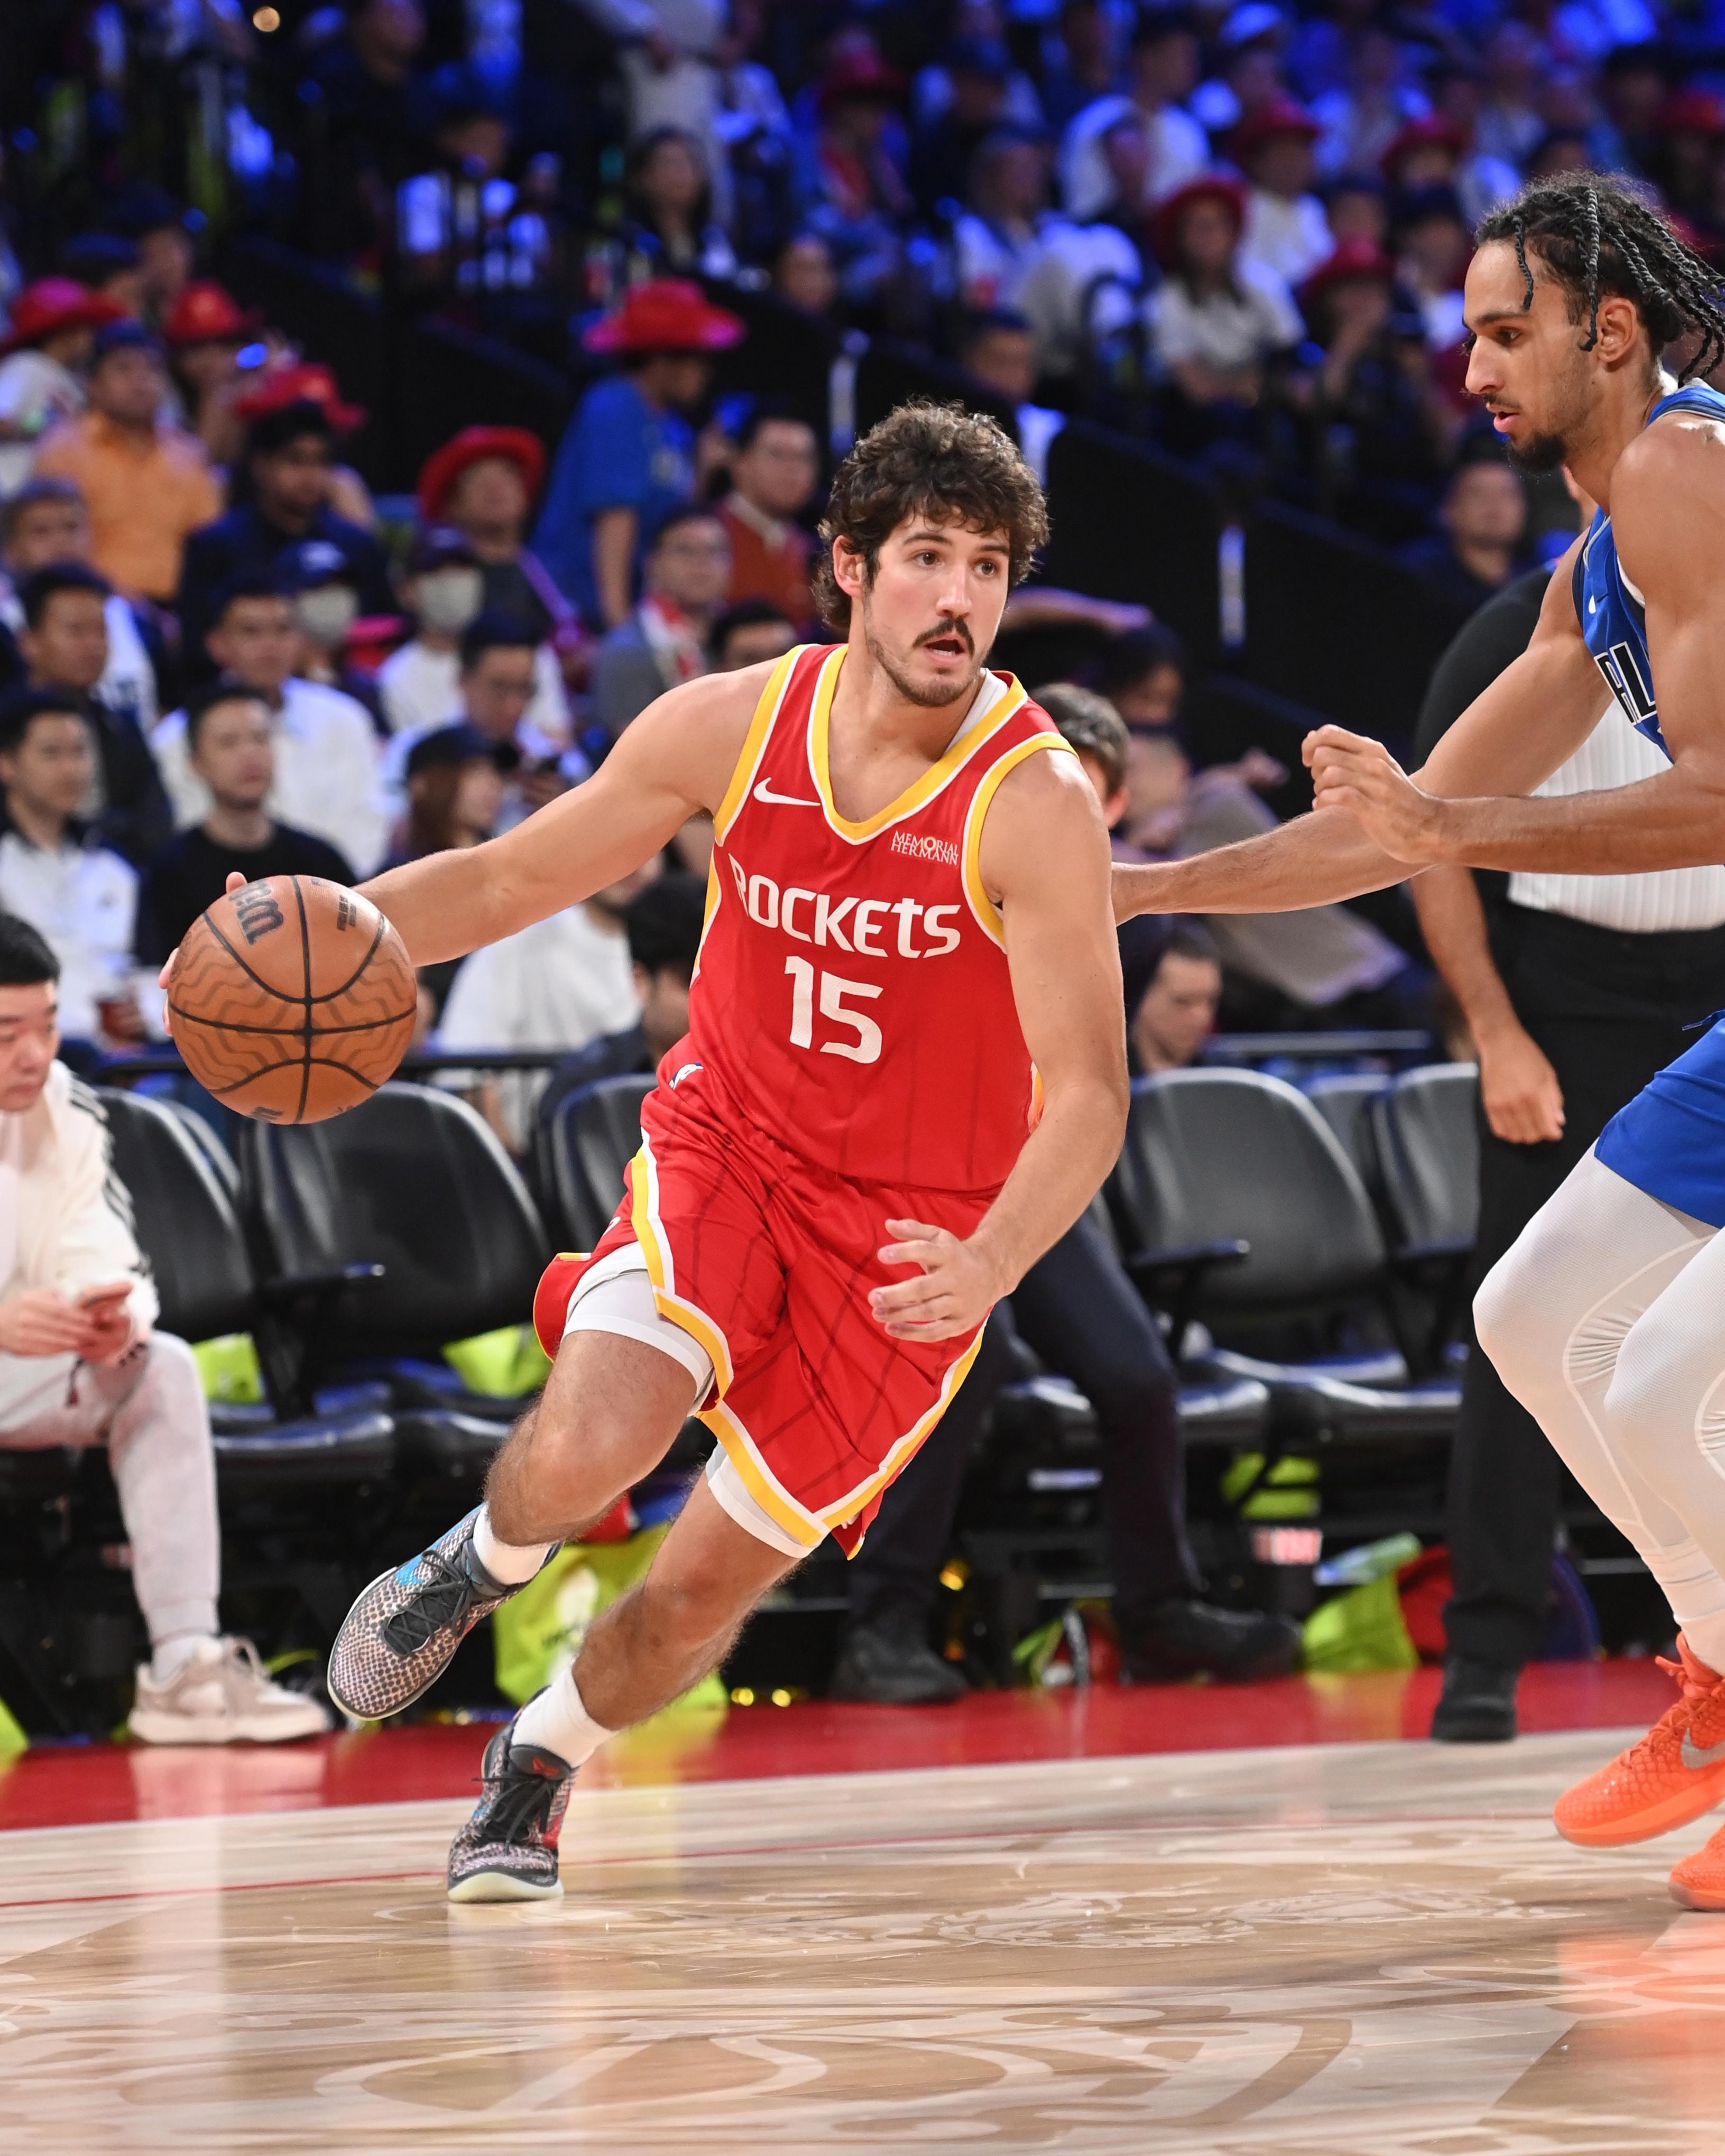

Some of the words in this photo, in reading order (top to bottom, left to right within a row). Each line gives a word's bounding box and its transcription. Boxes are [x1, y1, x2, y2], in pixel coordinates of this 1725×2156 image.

[891, 839, 958, 866] HERMANN
[892, 830, 958, 857] MEMORIAL
[784, 955, 883, 1064] 15
